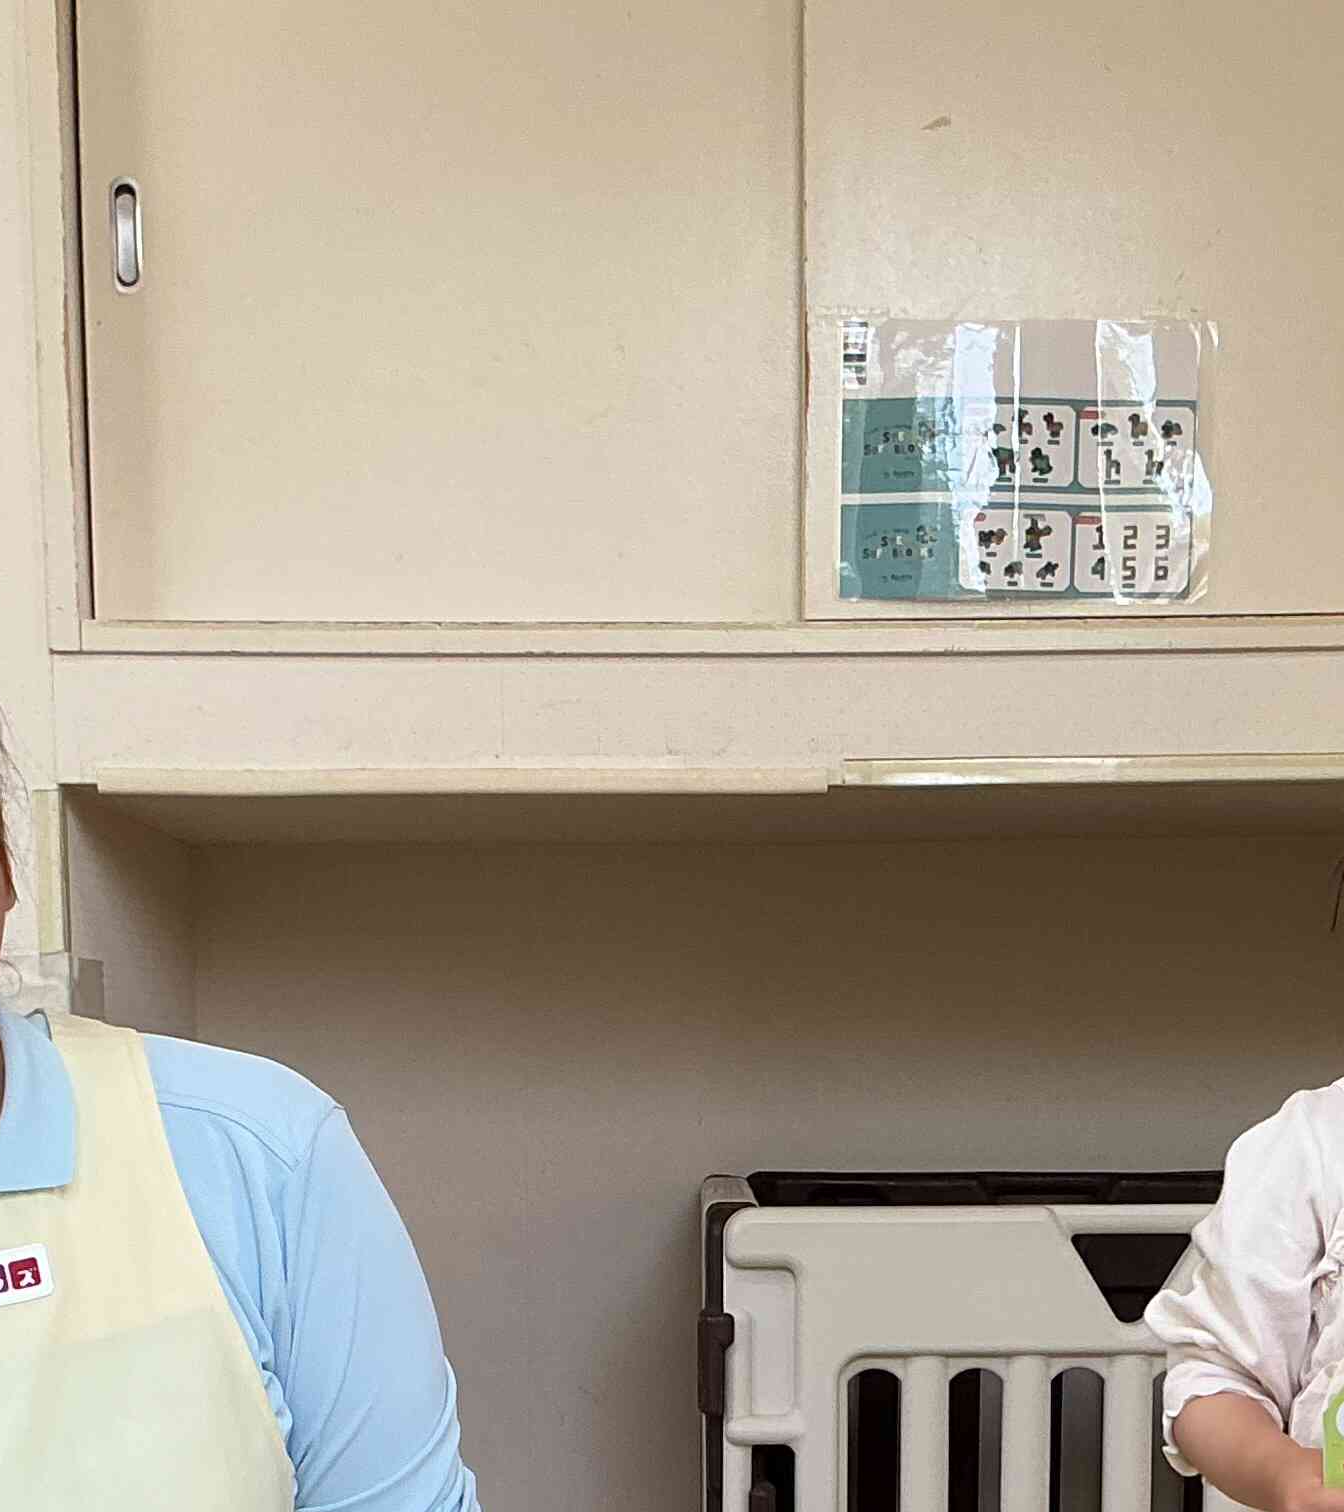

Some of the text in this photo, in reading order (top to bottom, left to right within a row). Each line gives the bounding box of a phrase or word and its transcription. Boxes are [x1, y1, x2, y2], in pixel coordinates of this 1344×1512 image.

[1123, 525, 1137, 549] 2
[1156, 525, 1170, 549] 3
[1091, 556, 1168, 580] 4 5 6
